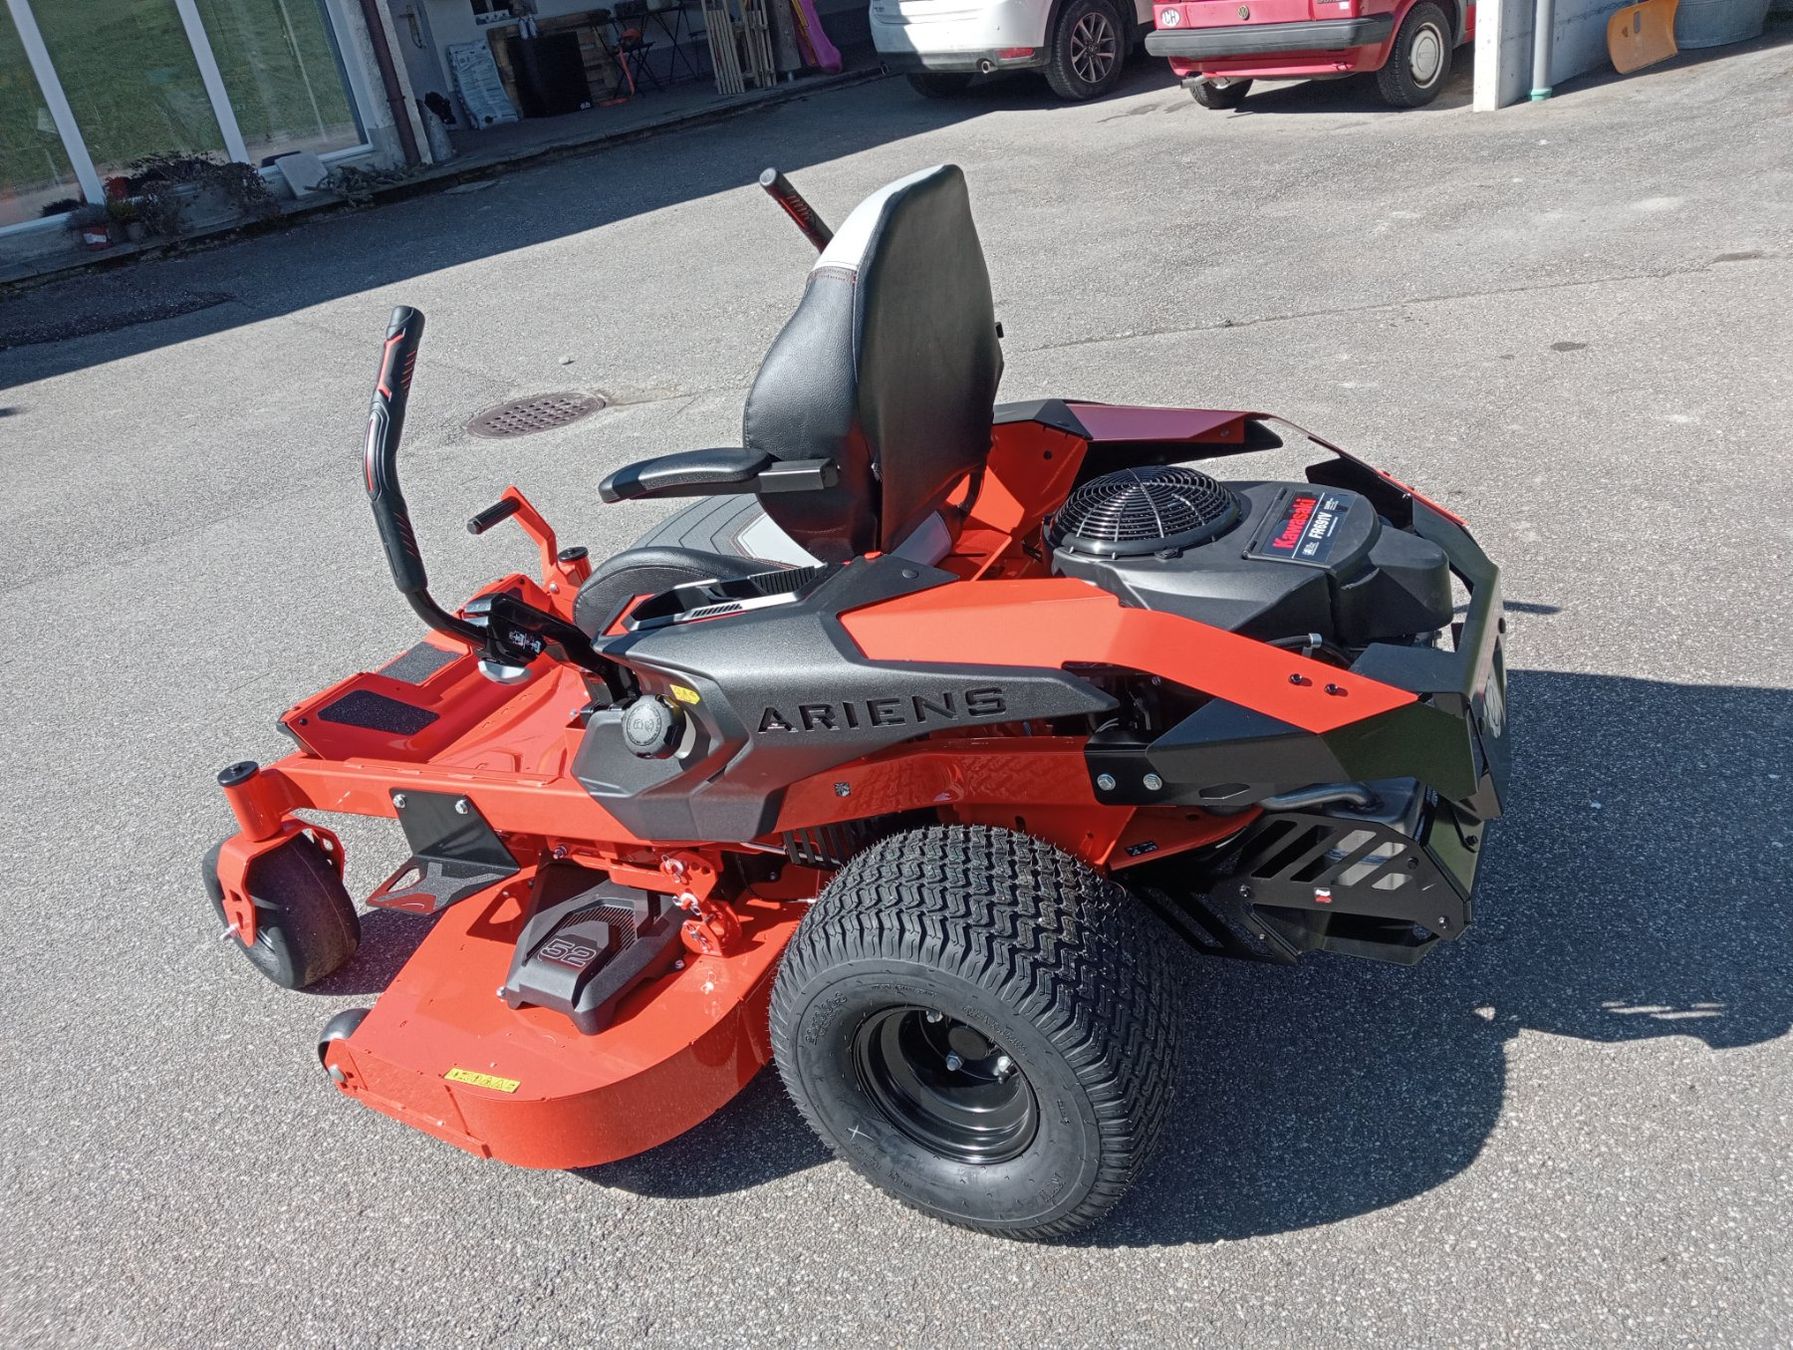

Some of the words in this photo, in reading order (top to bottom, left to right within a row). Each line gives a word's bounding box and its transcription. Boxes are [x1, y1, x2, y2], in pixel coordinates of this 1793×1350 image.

[1273, 497, 1317, 548] Kawasaki
[757, 686, 1008, 734] ARIENS
[538, 939, 597, 967] 52
